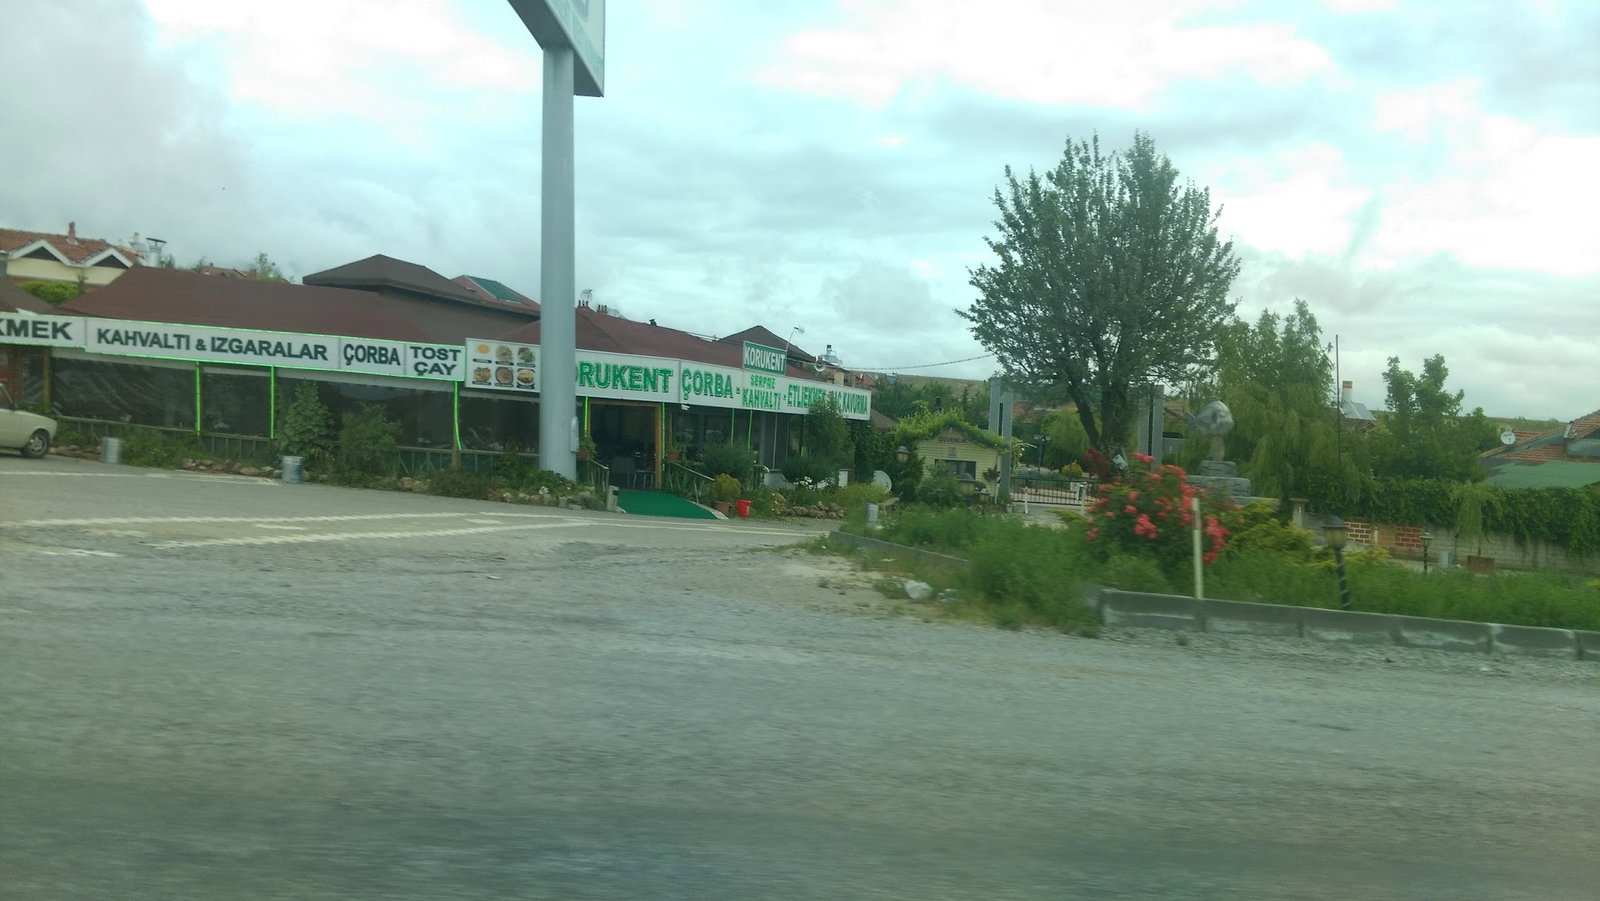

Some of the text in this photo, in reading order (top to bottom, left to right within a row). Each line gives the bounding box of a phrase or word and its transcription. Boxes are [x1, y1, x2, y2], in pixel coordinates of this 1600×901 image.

[97, 328, 328, 361] KAHVALTI & IZGARALAR
[343, 343, 401, 366] ÇORBA
[410, 346, 461, 362] TOST
[414, 362, 456, 376] ÇAY
[744, 347, 785, 371] KORUKENT
[575, 361, 673, 393] RUKENT
[681, 368, 733, 400] ÇORBA
[742, 387, 781, 410] KAHVALTI
